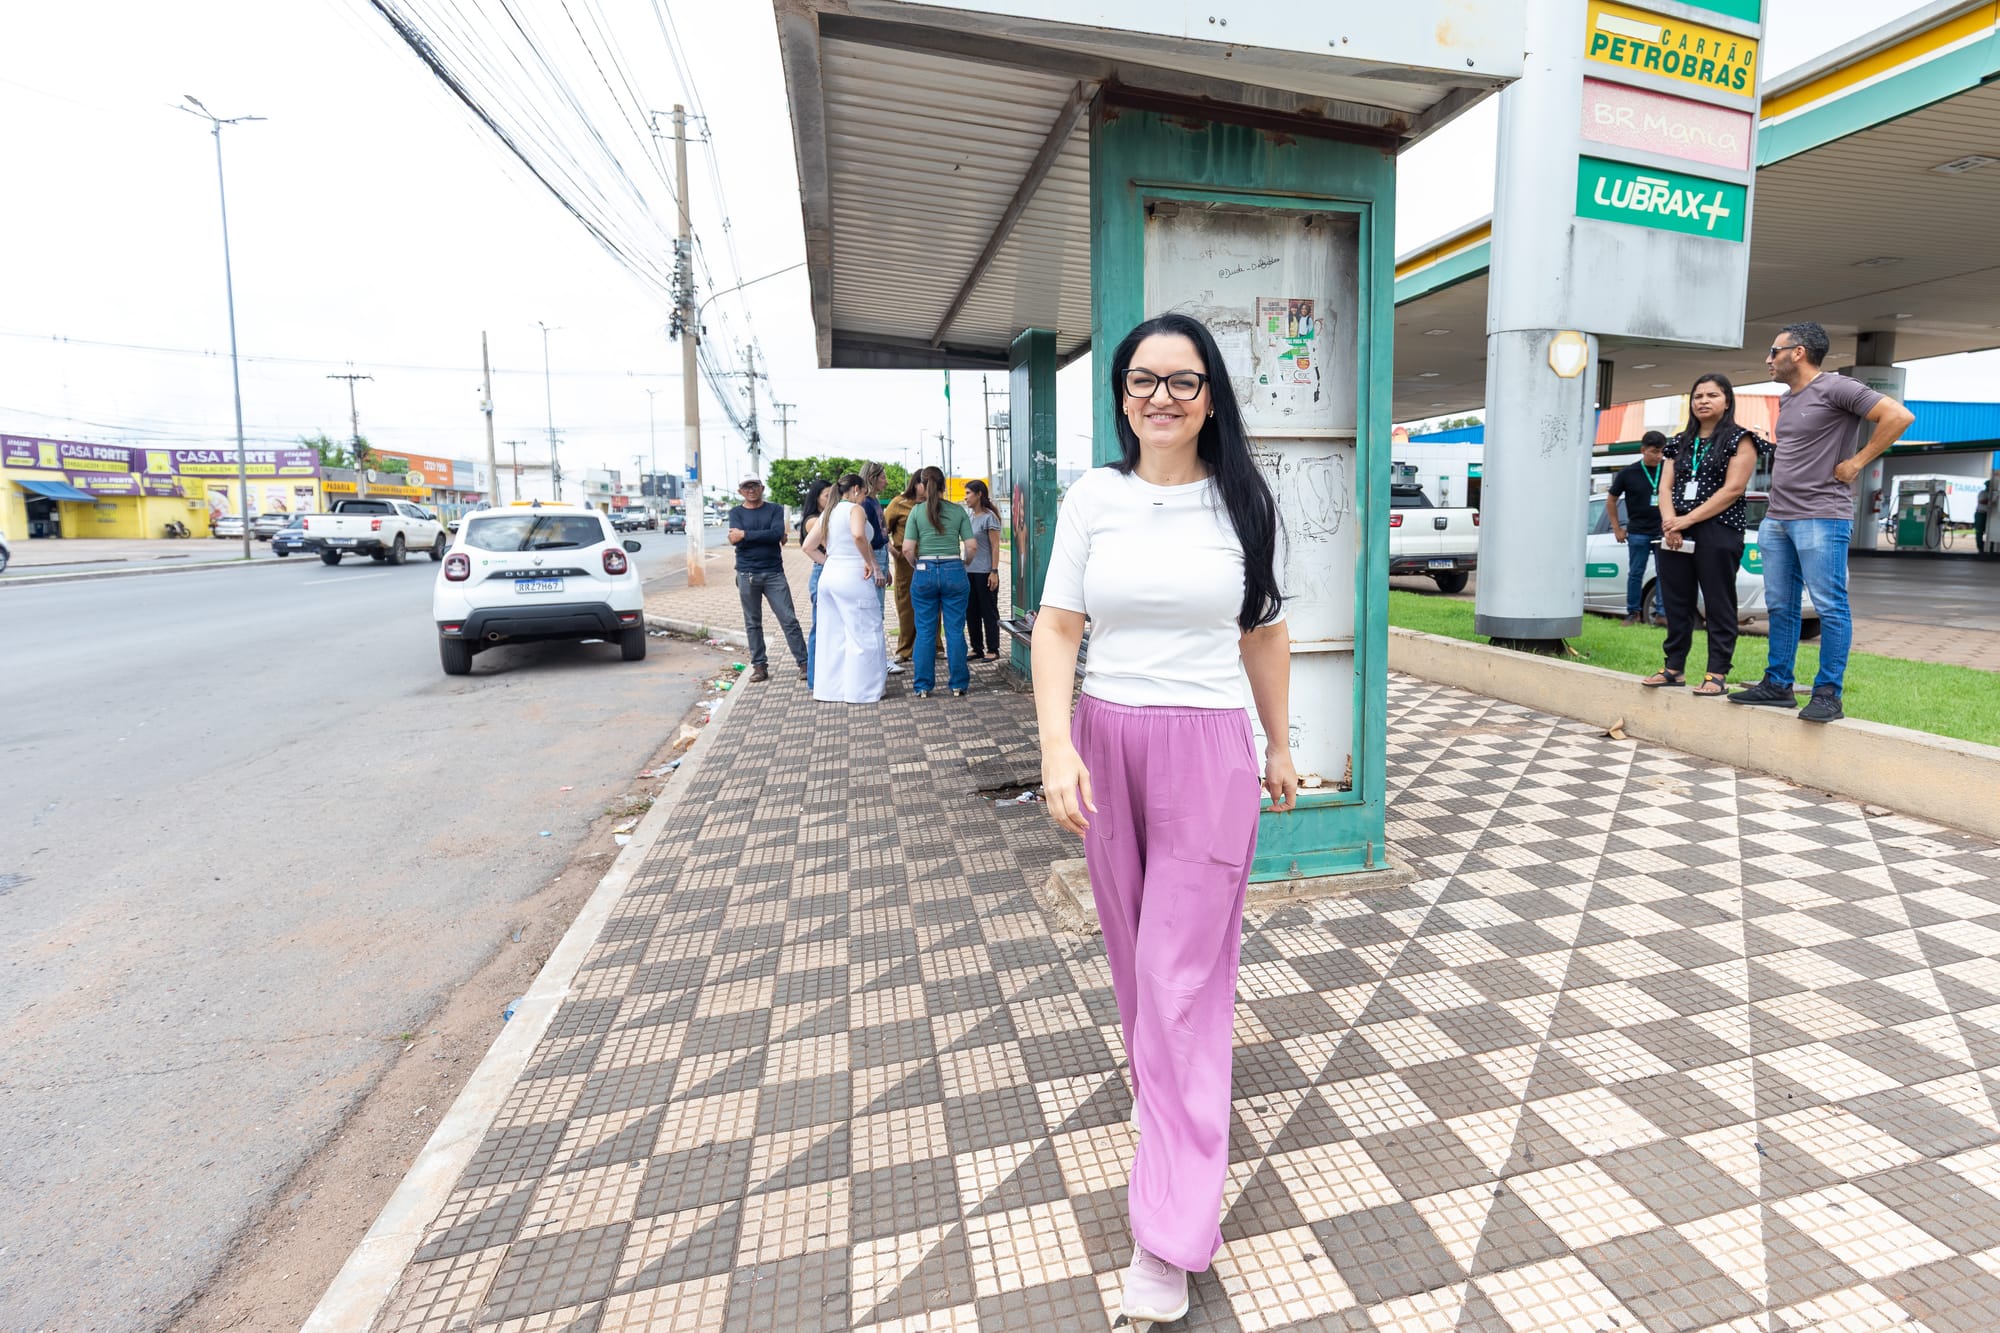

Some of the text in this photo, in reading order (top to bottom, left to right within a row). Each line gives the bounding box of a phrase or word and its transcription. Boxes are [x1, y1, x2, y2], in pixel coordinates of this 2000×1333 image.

[1662, 29, 1752, 66] CARTÃO
[1590, 33, 1747, 90] PETROBRAS
[1594, 103, 1638, 130] BR
[60, 444, 130, 461] CASA FORTE
[175, 450, 220, 463] CASA
[505, 569, 571, 577] DUSTER
[519, 583, 559, 592] RRZ7H67
